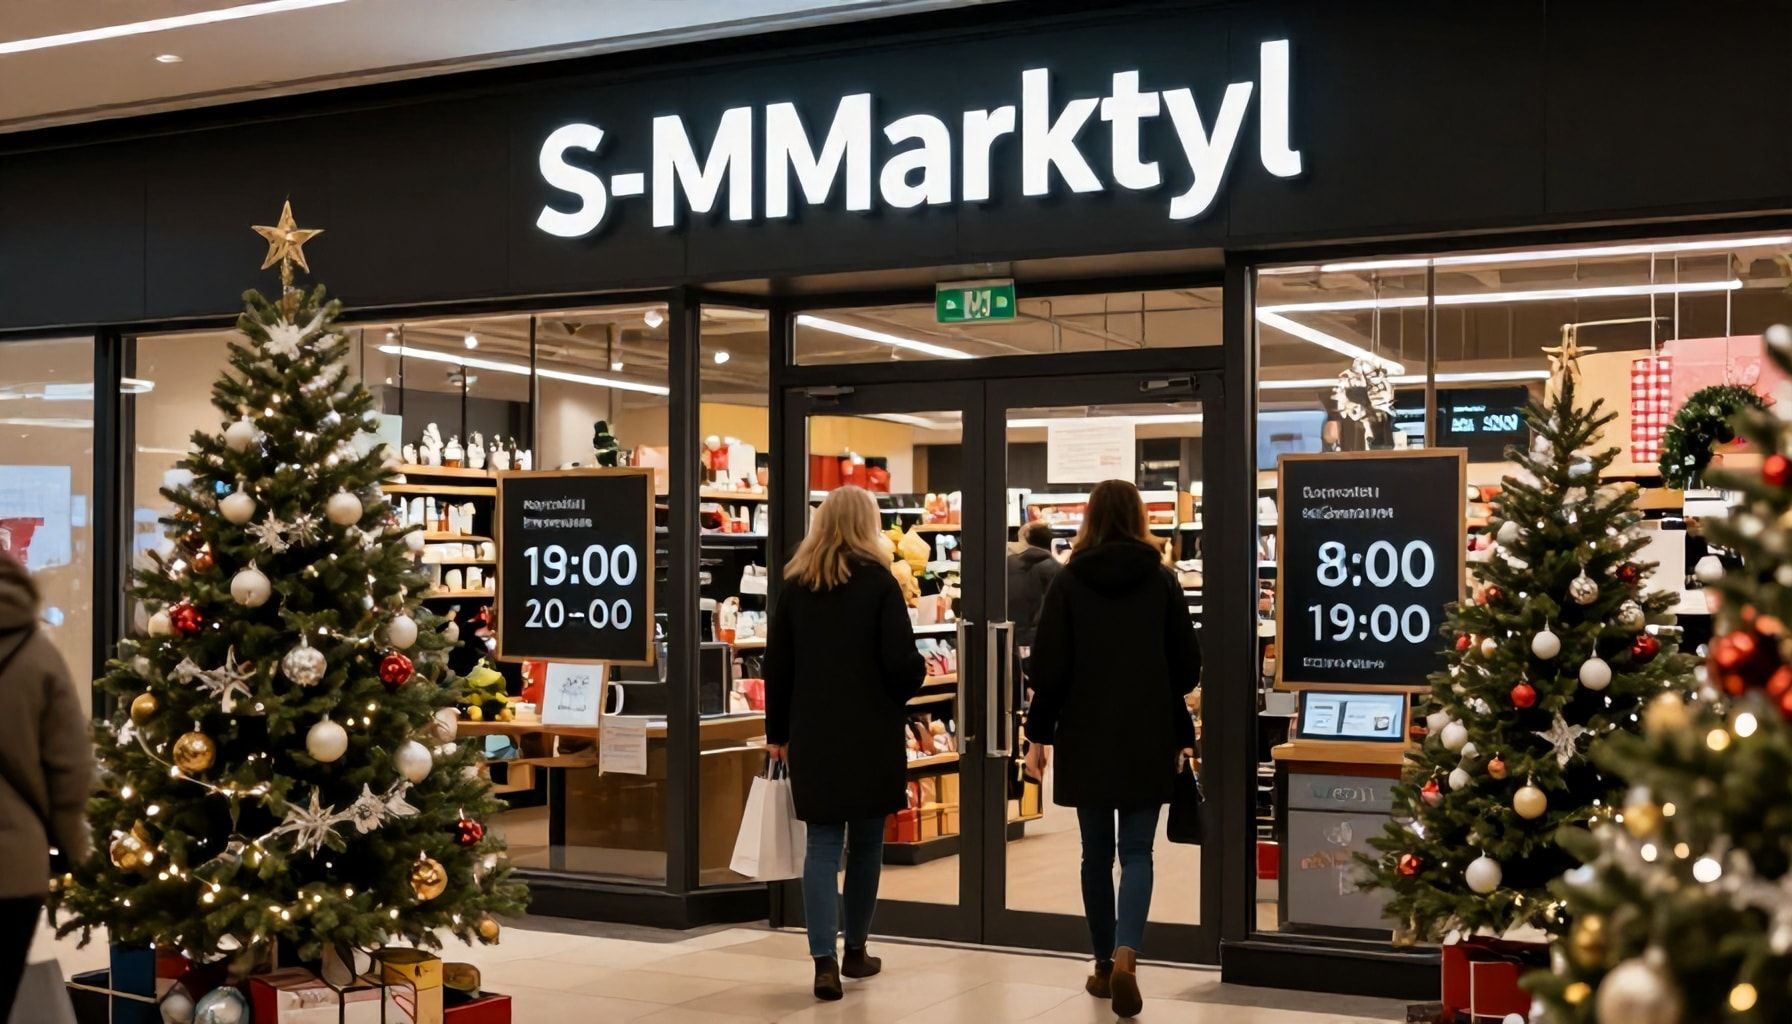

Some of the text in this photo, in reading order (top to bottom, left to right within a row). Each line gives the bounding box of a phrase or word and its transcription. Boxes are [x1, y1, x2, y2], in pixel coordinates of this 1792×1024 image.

[536, 39, 1302, 238] S-MMarktyl
[523, 543, 638, 587] 19:00
[1316, 539, 1435, 588] 8:00
[1308, 602, 1431, 644] 19:00
